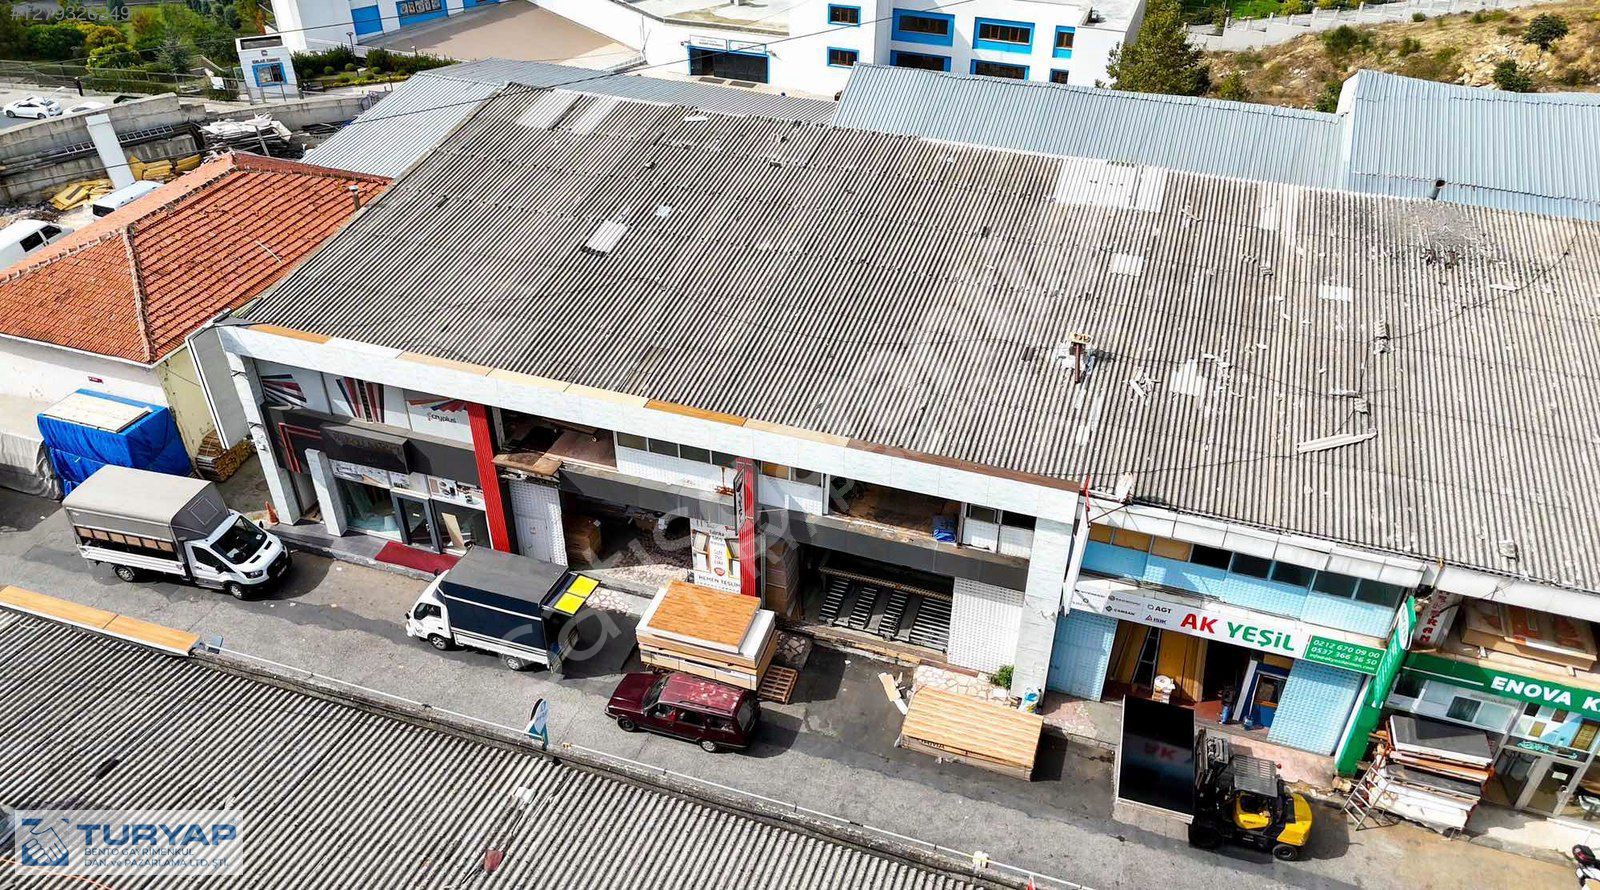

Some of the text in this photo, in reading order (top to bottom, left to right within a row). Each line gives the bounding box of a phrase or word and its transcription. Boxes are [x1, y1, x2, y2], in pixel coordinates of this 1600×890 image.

[1155, 605, 1172, 614] AGT
[1180, 613, 1218, 634] AK
[1311, 647, 1333, 656] 0537
[1313, 640, 1335, 650] 0212
[1337, 645, 1354, 653] 670
[1368, 651, 1380, 659] 00
[1490, 676, 1571, 706] ENOVA
